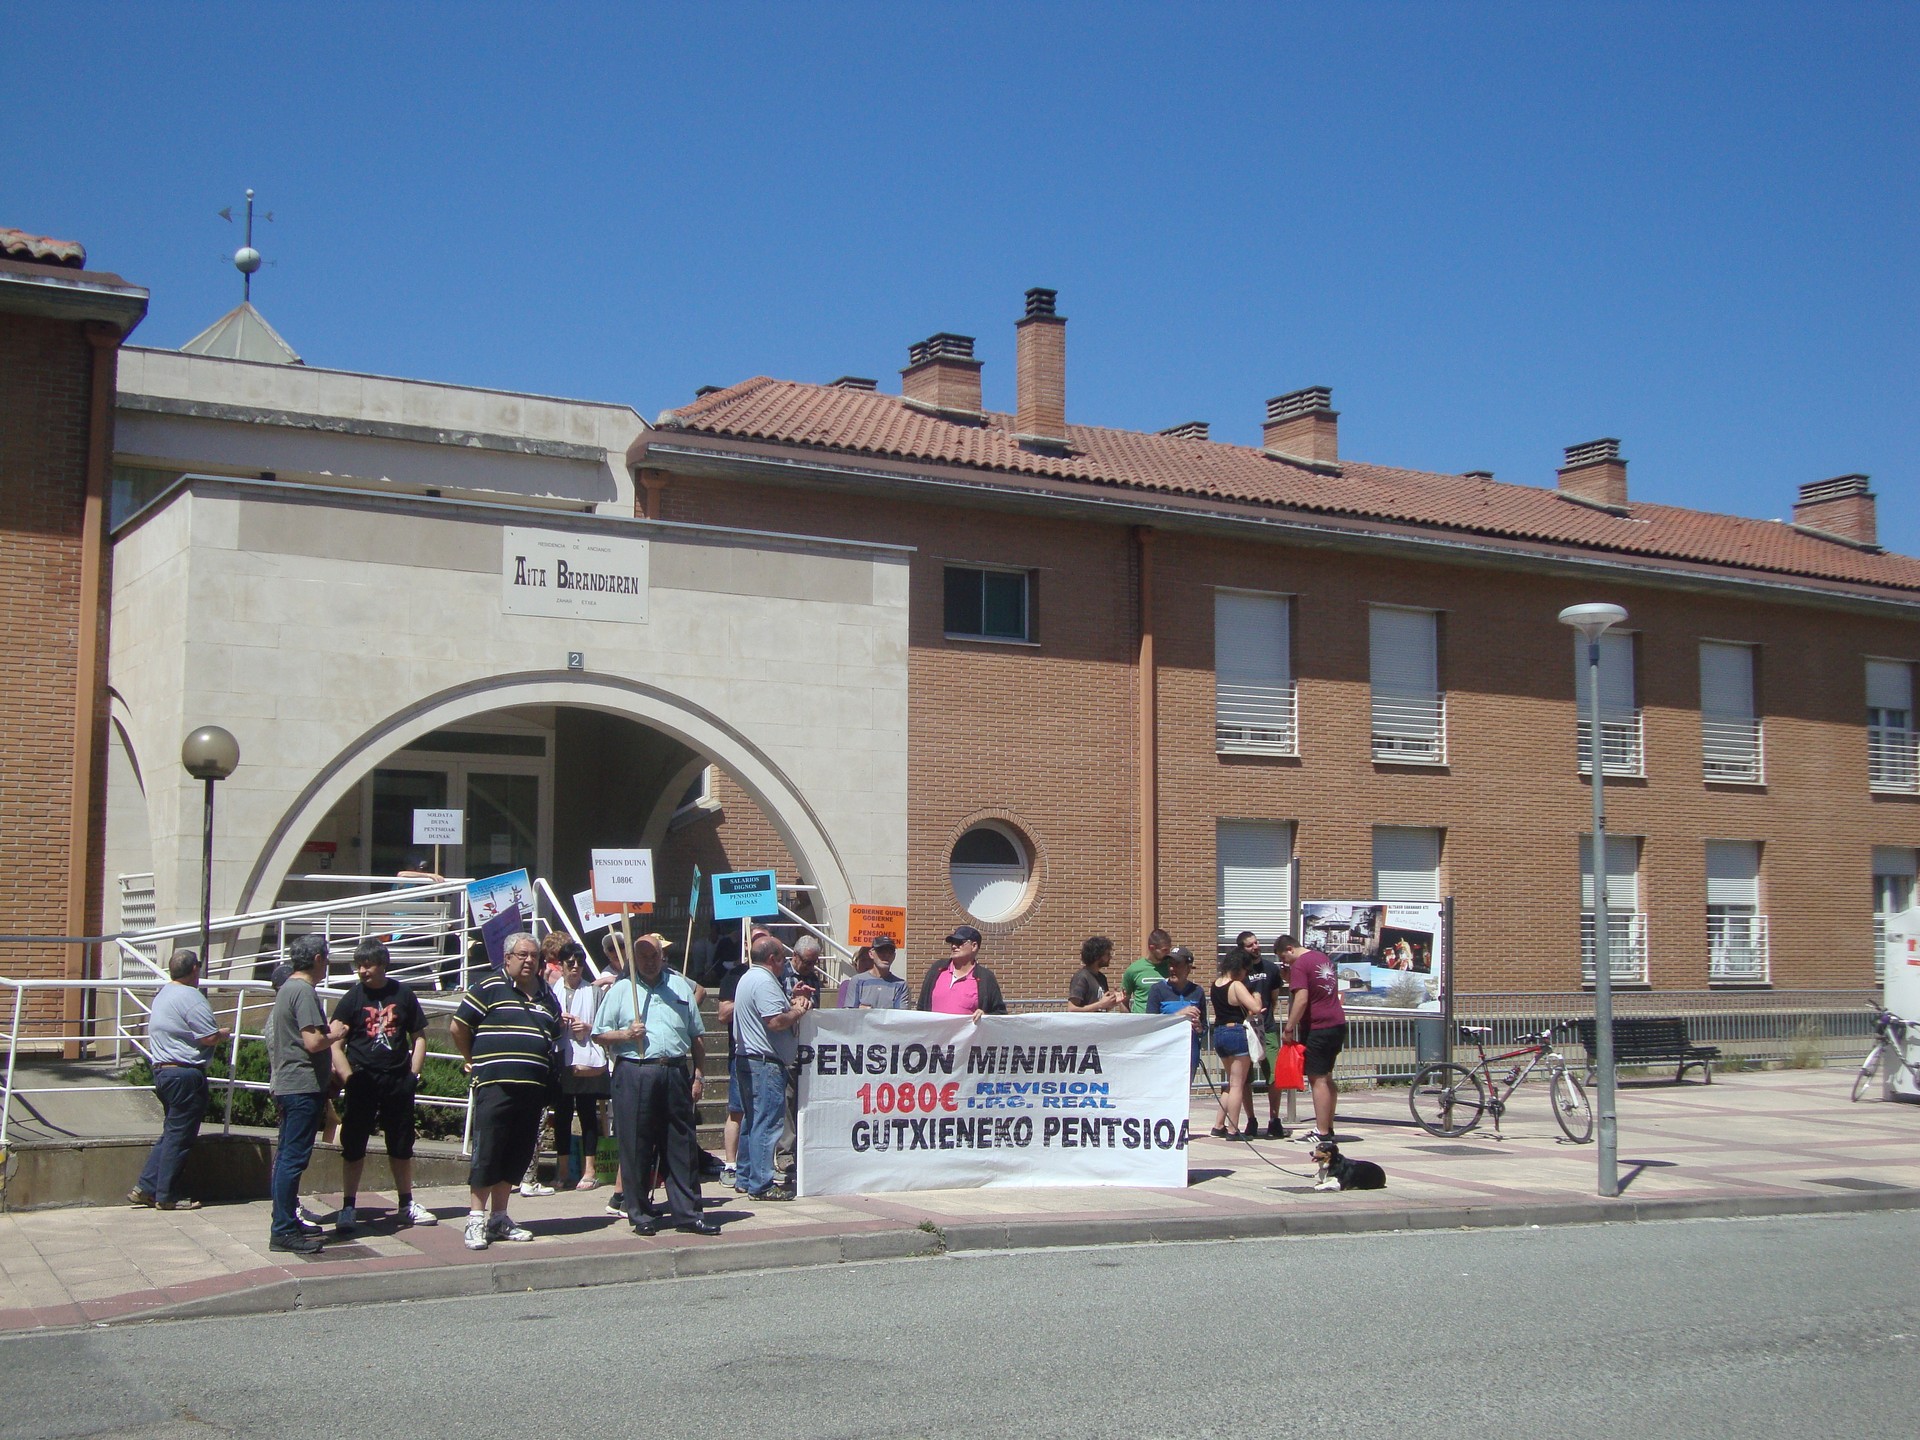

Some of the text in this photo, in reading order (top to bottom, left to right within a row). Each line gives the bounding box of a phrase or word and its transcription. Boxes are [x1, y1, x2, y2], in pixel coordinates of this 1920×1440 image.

[571, 654, 580, 666] 2
[624, 859, 647, 867] DUINA
[611, 876, 634, 884] 1.080€
[797, 1043, 1103, 1076] PENSION MINIMA
[856, 1081, 1110, 1115] 1.080€ REVISION
[967, 1095, 1117, 1109] I.P.C. REAL
[851, 1116, 1033, 1153] GUTXIENEKO
